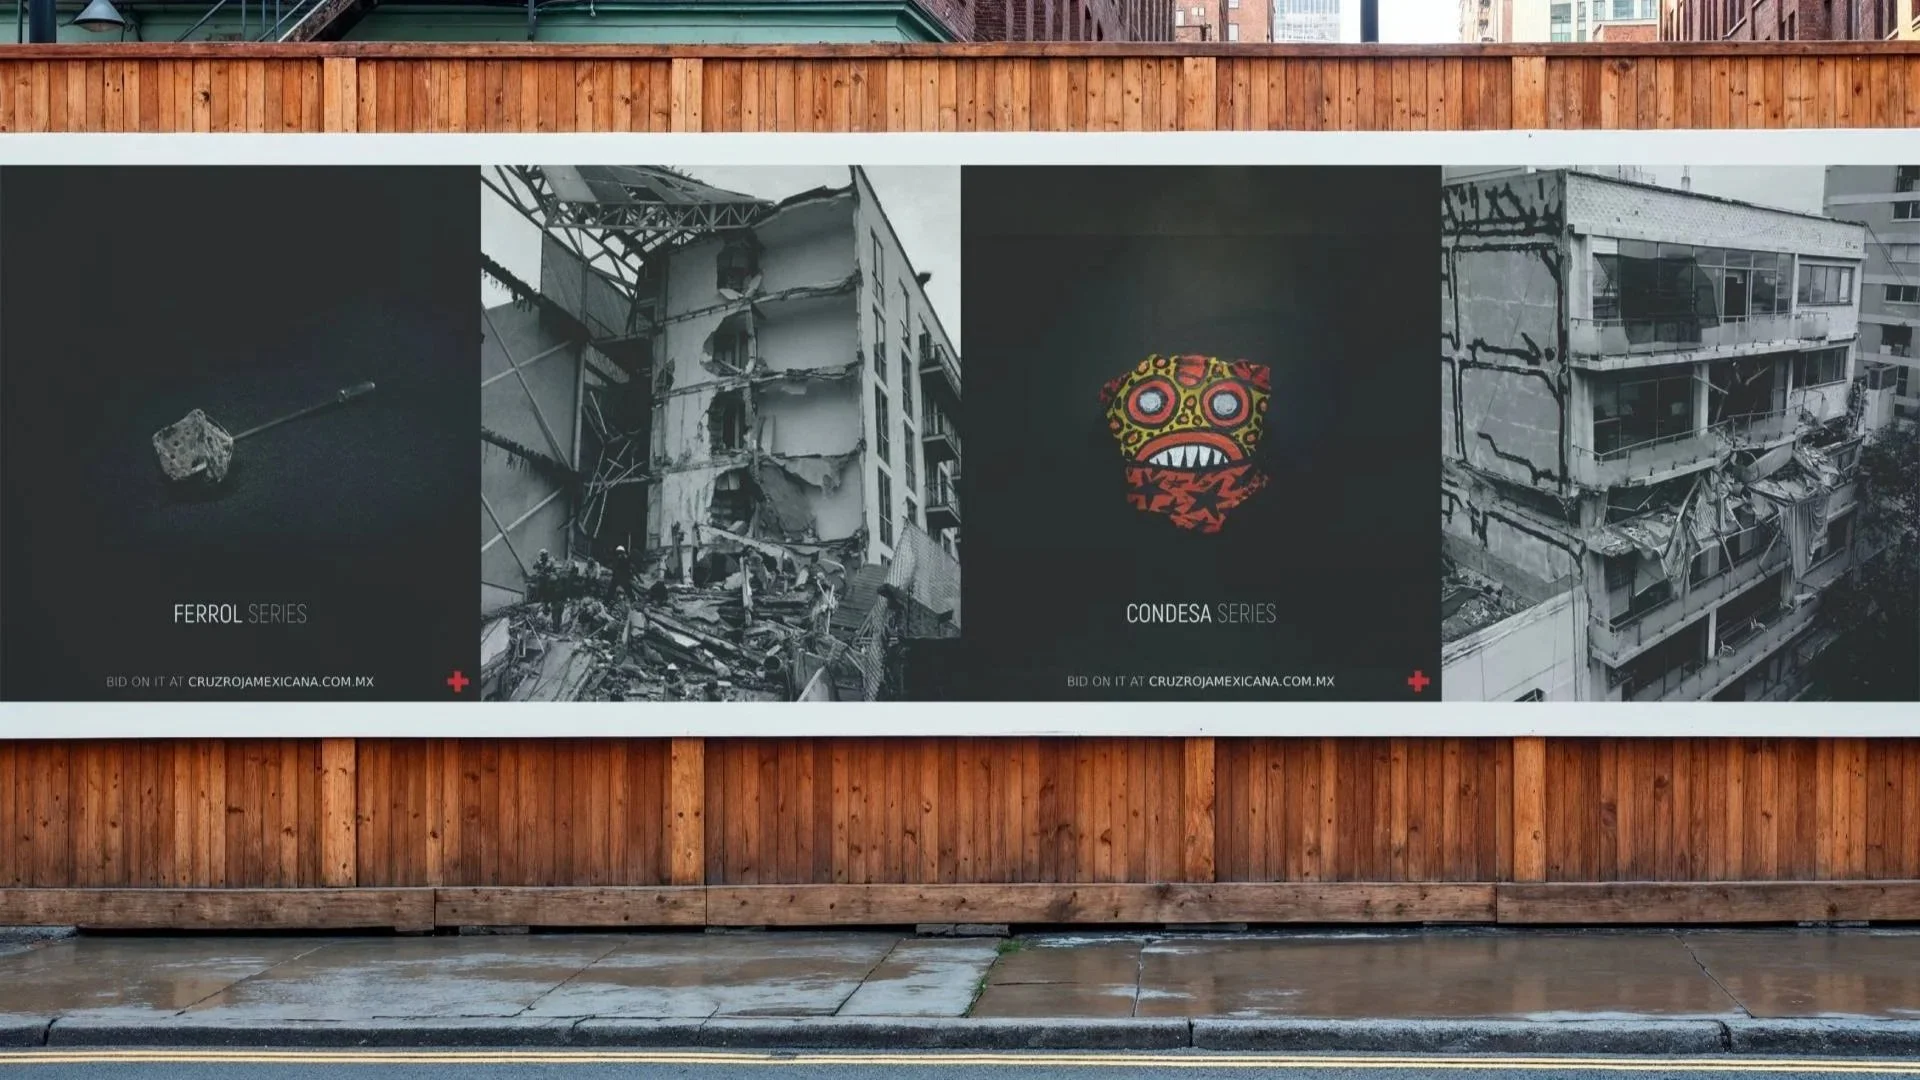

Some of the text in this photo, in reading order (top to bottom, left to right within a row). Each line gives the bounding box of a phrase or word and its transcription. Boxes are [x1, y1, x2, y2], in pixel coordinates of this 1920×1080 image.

[173, 603, 308, 624] FERROL SERIES
[1126, 602, 1277, 624] CONDESA SERIES
[106, 675, 375, 690] BID ON IT AT CRUZROJAMEXICANA.COM.MX
[1067, 675, 1336, 690] BID ON IT AT CRUZROJAMEXICANA.COM.MX
